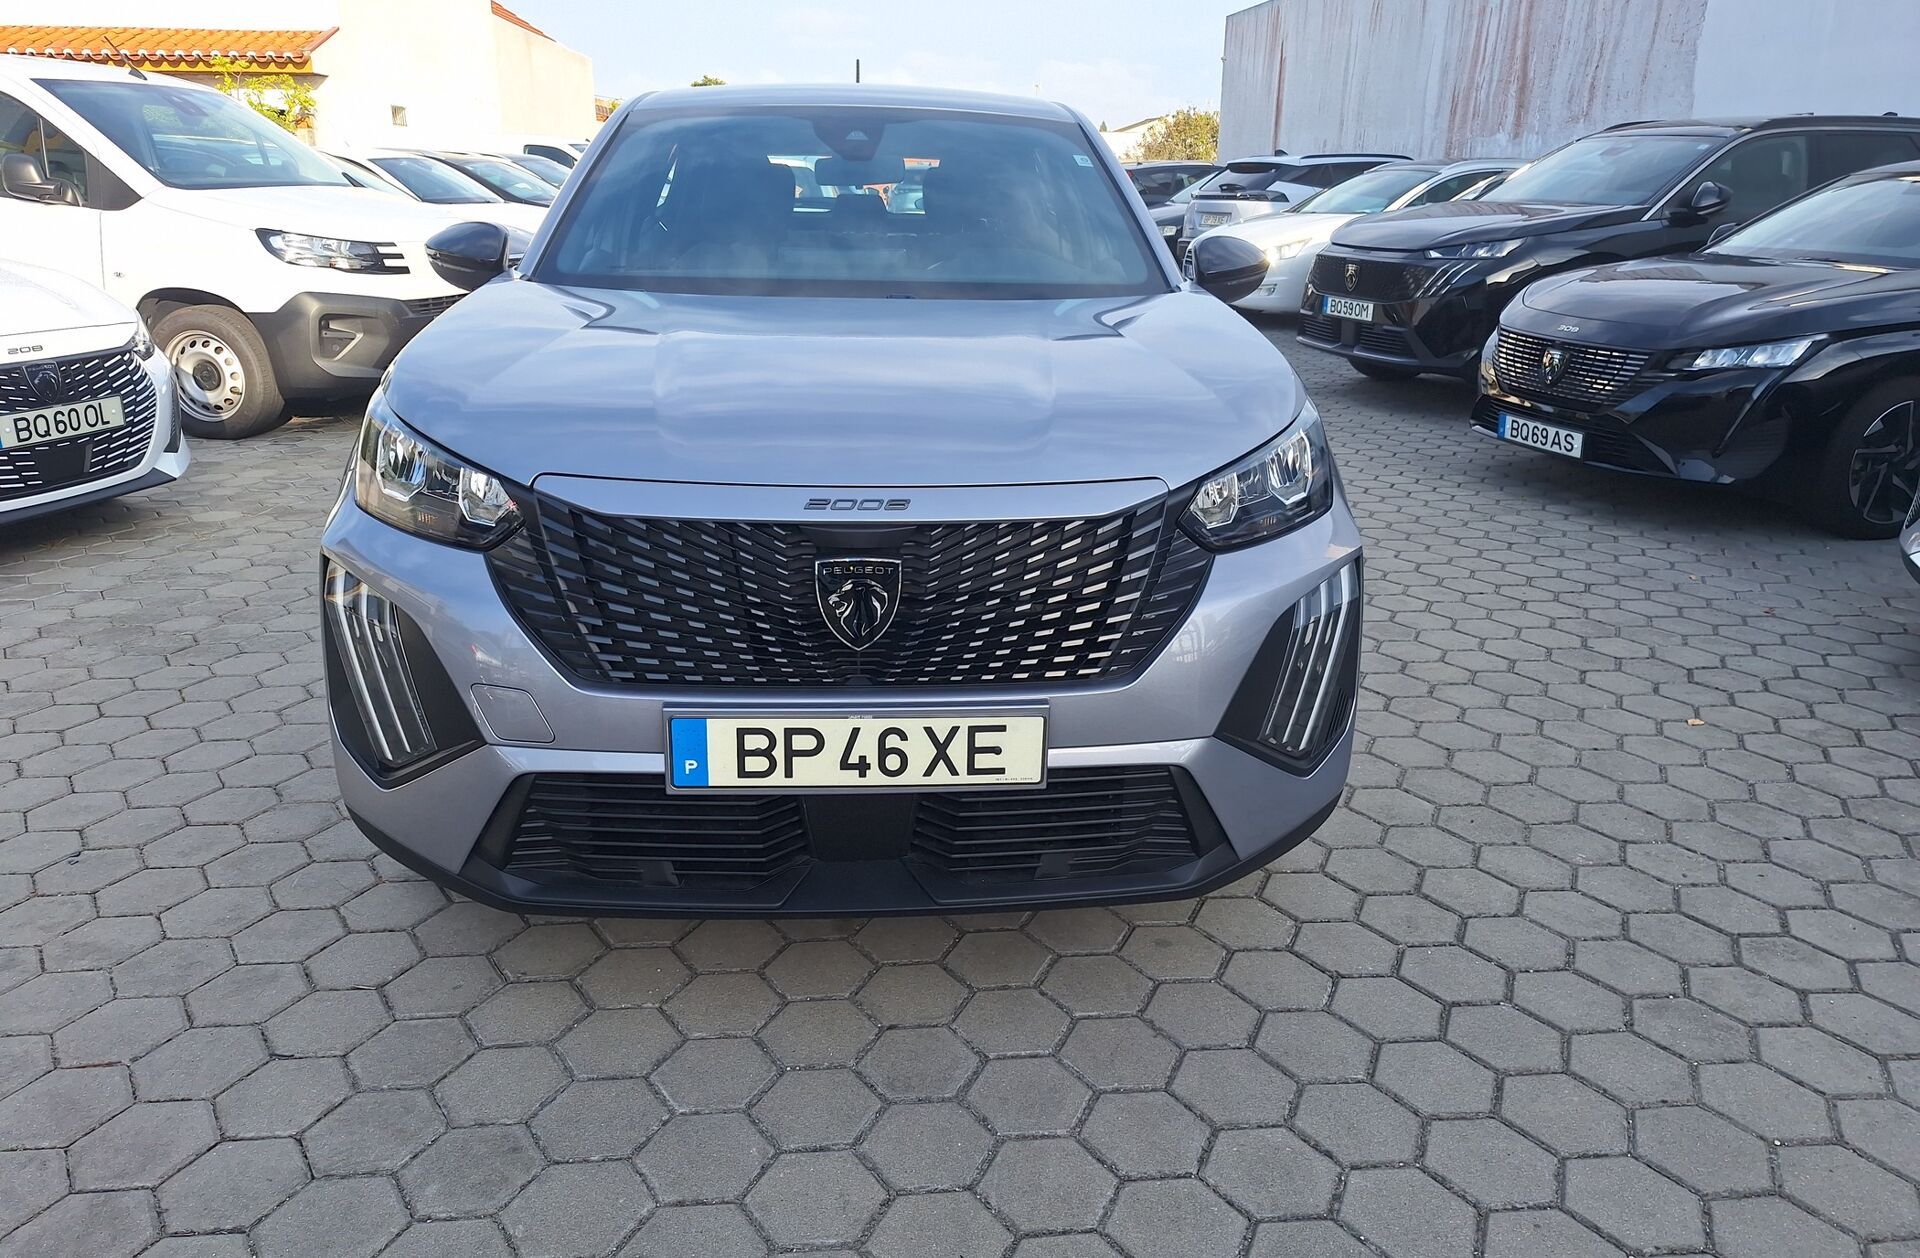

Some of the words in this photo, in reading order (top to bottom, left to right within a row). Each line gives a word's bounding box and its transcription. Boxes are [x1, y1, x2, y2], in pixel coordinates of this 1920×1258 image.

[1557, 324, 1580, 333] 308
[8, 345, 43, 354] 208
[13, 413, 51, 443] BQ
[53, 407, 81, 435] 60
[84, 402, 110, 427] OL
[1510, 419, 1530, 442] BQ
[1531, 425, 1549, 446] 69
[1550, 430, 1575, 452] AS
[804, 498, 911, 511] 2008
[823, 566, 894, 576] PEUGEOT
[736, 727, 826, 779] BP
[840, 726, 909, 778] 46
[922, 724, 1008, 777] XE
[684, 759, 698, 775] P
